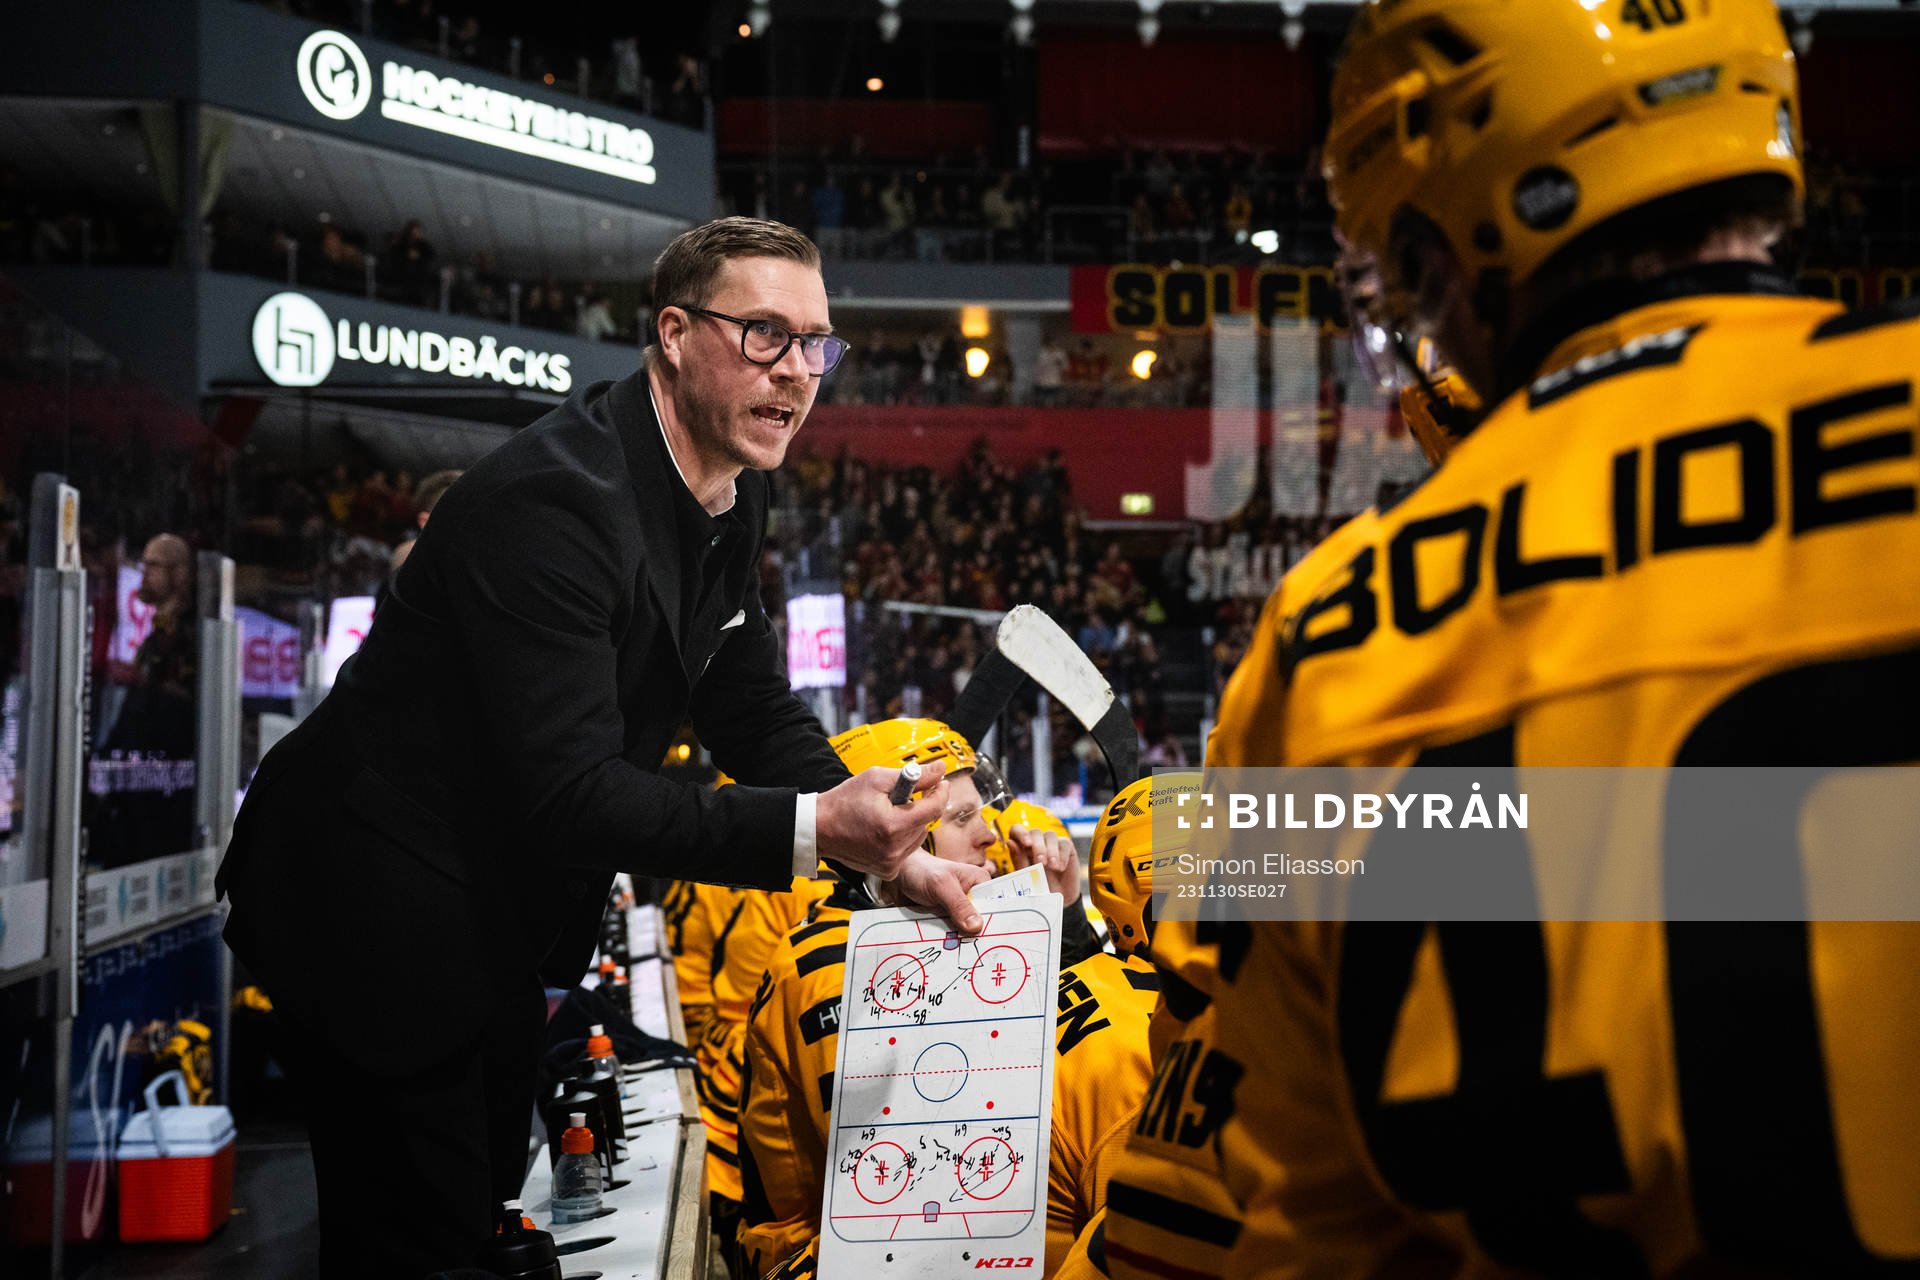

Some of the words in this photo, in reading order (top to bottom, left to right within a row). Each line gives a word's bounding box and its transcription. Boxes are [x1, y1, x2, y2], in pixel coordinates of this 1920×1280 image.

[383, 61, 654, 165] HOCKEYBISTRO
[338, 318, 572, 392] LUNDBÄCKS
[1149, 784, 1201, 799] Skellefteå
[1148, 796, 1174, 808] Kraft
[974, 1257, 1034, 1269] CCM
